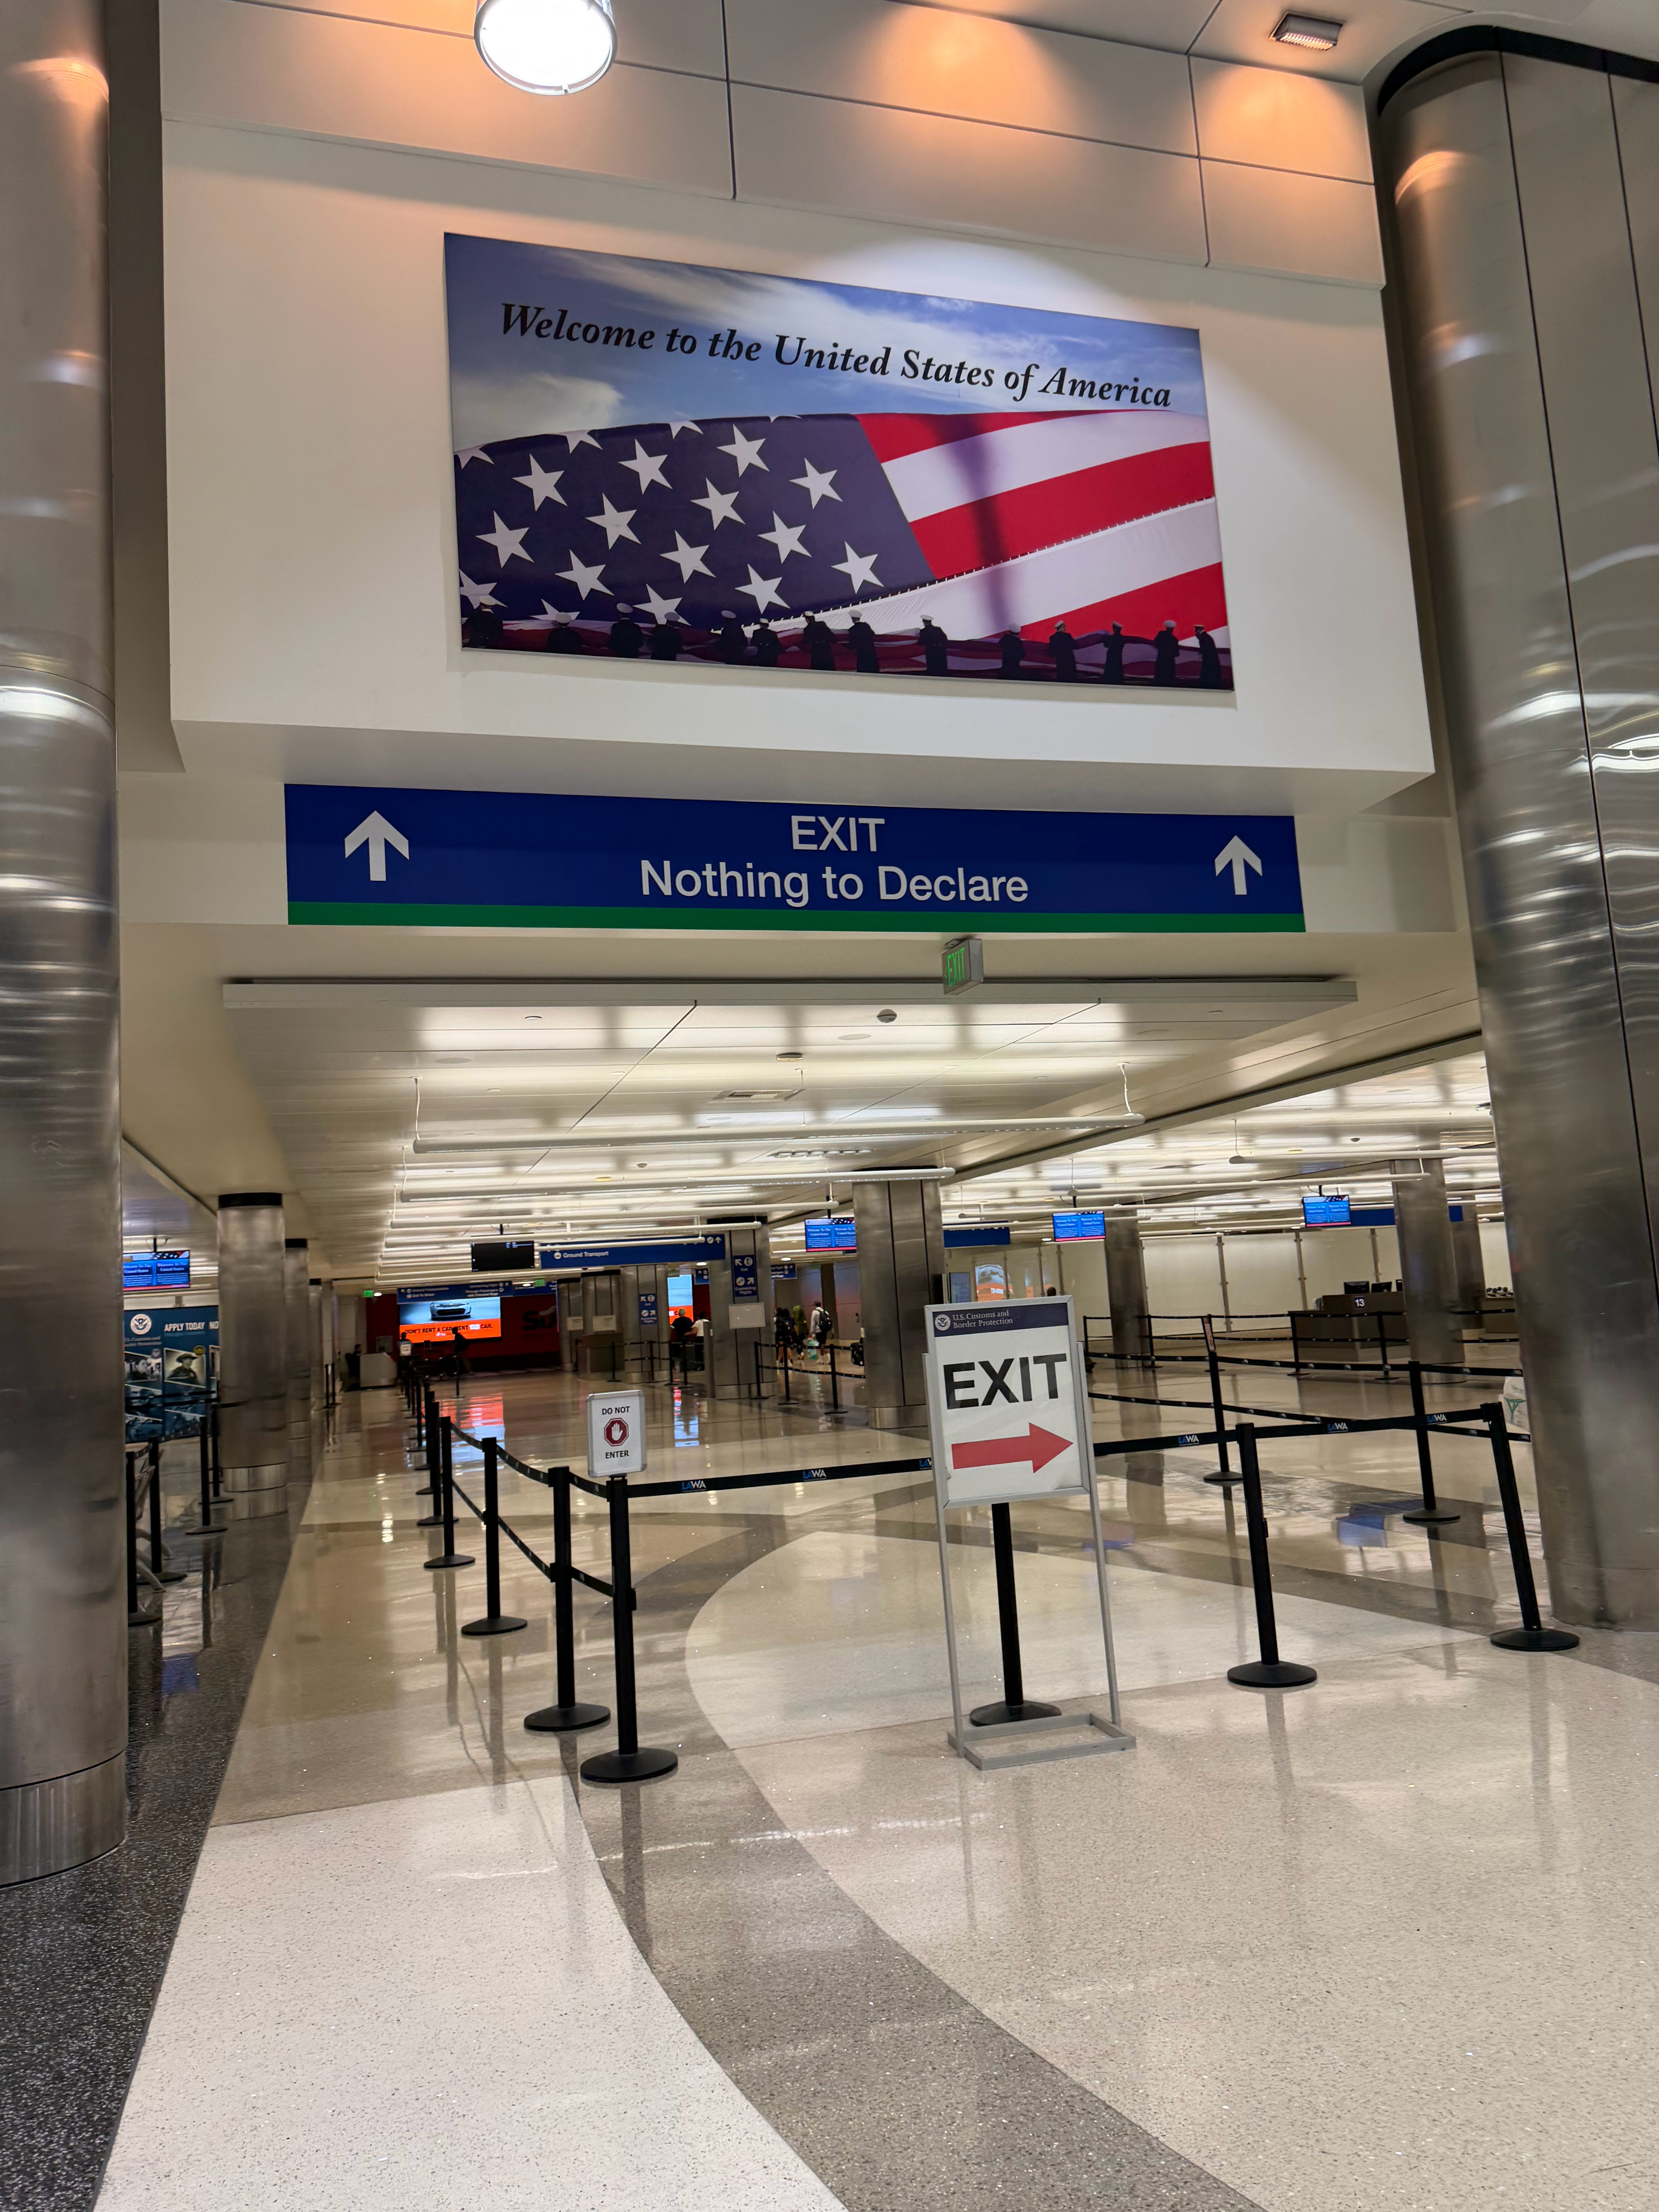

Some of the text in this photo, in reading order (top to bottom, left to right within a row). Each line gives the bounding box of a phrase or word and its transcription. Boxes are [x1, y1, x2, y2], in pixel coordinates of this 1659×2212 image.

[502, 303, 1171, 407] Welcome to the United States of America
[791, 815, 885, 852] EXIT
[641, 860, 1028, 907] Nothing to Declare
[947, 947, 965, 987] EXIT
[1355, 1298, 1365, 1307] 13
[164, 1322, 205, 1332] APPLY TODAY
[979, 1318, 1013, 1326] Protection
[943, 1353, 1067, 1410] EXIT
[1426, 1414, 1447, 1422] LAWA
[1327, 1422, 1348, 1431] LAWA
[1178, 1434, 1199, 1444] LAWA
[605, 1450, 629, 1459] ENTER
[803, 1469, 826, 1480] LAWA
[682, 1480, 706, 1491] LAWA
